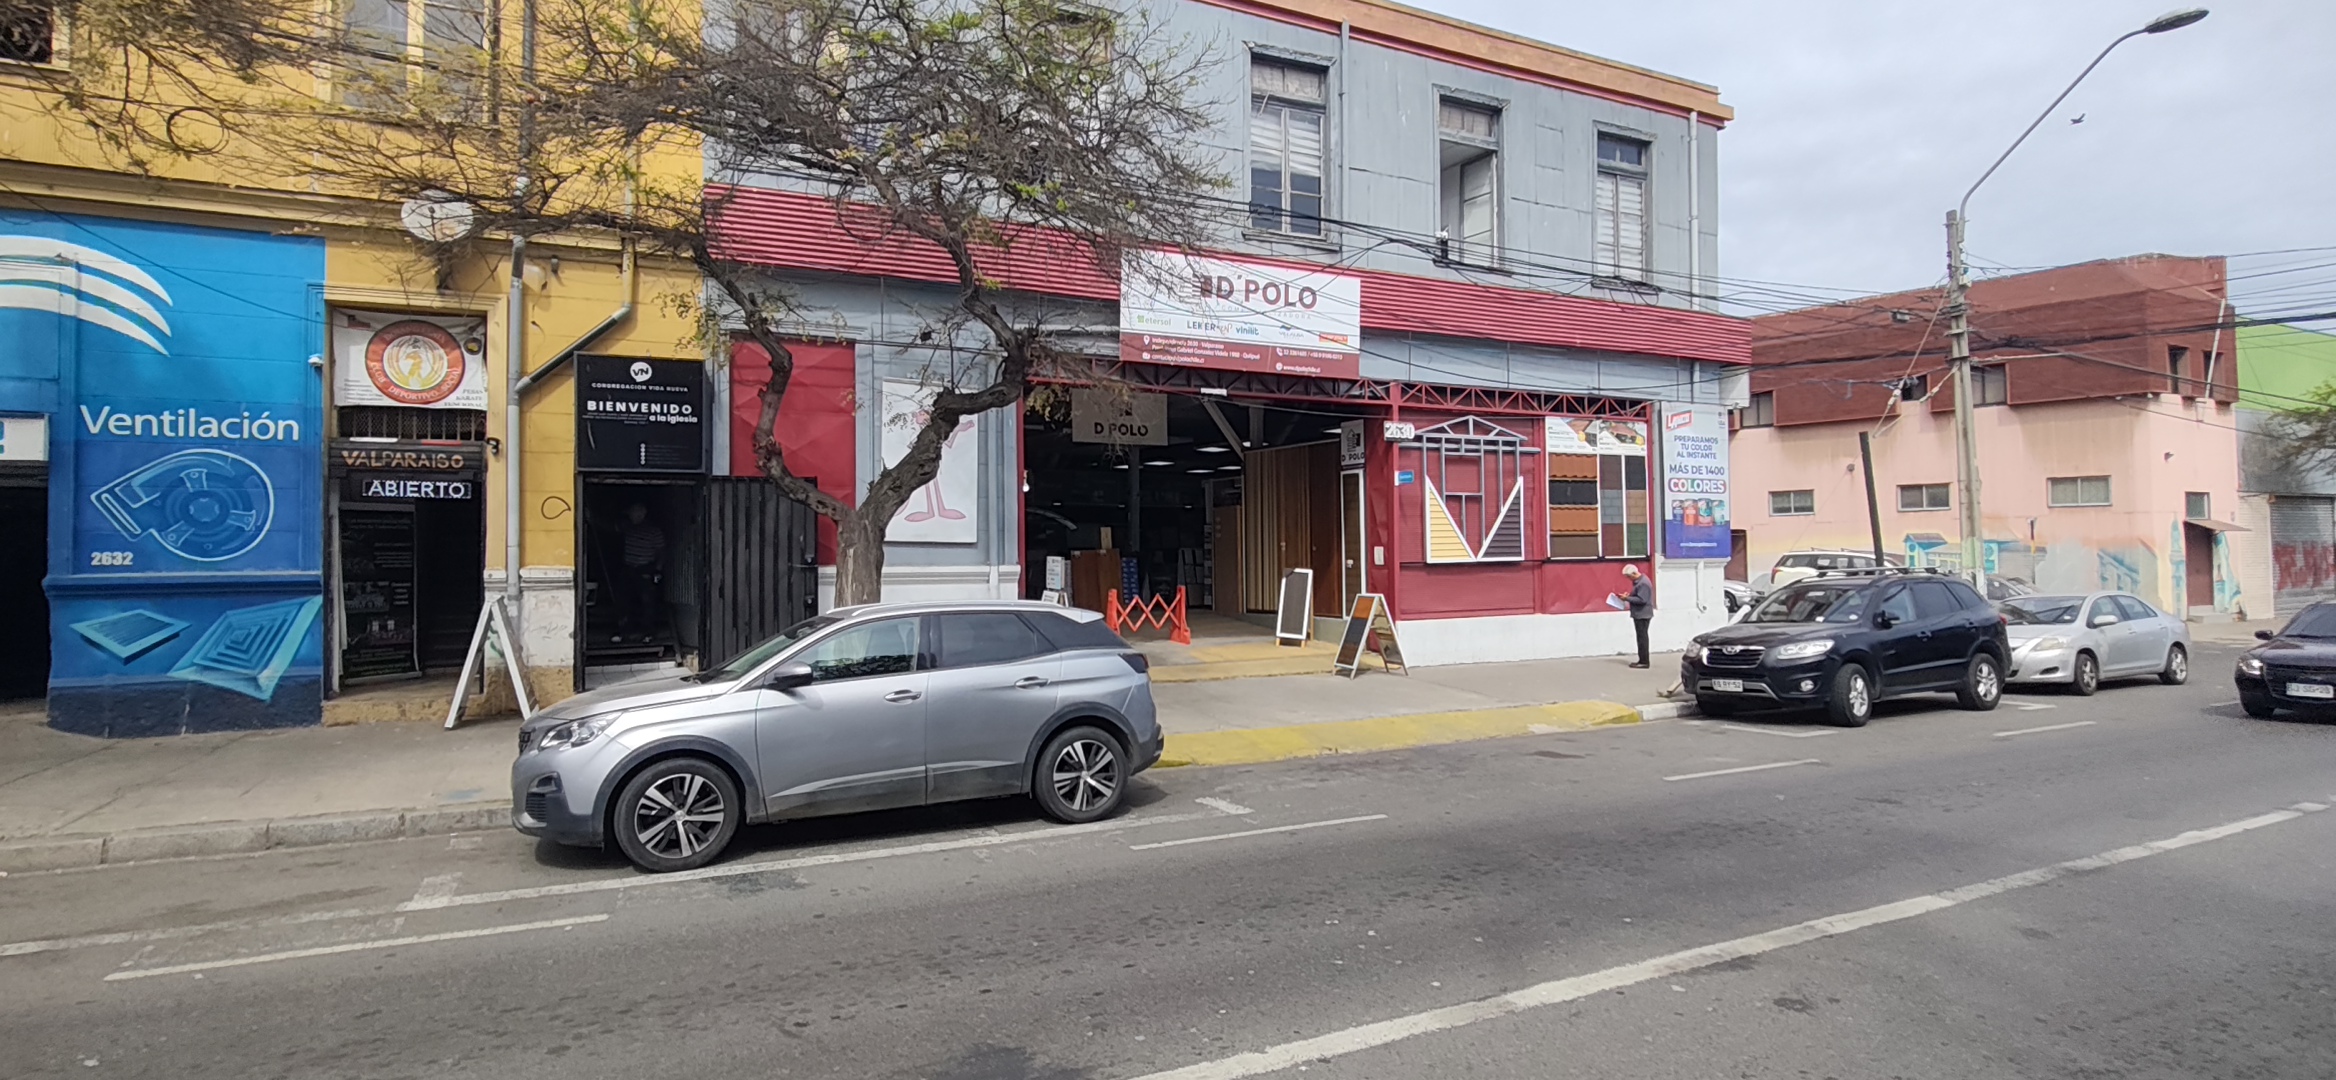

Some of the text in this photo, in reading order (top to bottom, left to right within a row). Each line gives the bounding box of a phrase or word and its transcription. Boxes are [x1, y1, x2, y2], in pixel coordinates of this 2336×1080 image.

[388, 385, 439, 401] DEPORTIVO
[586, 400, 693, 415] BIENVENIDO
[80, 405, 300, 442] Ventilación
[657, 414, 667, 422] la
[667, 414, 699, 425] iglesia
[1384, 422, 1416, 440] 2630
[1673, 435, 1719, 445] PREPARAMOS
[1680, 443, 1713, 452] TU COLOR
[340, 450, 465, 469] VALPARAISO
[1676, 451, 1717, 460] AL INSTANTE
[1669, 462, 1725, 476] MÁS DE 1400
[368, 479, 466, 499] ABIERTO
[1669, 478, 1725, 493] COLORES
[90, 551, 134, 567] 2632
